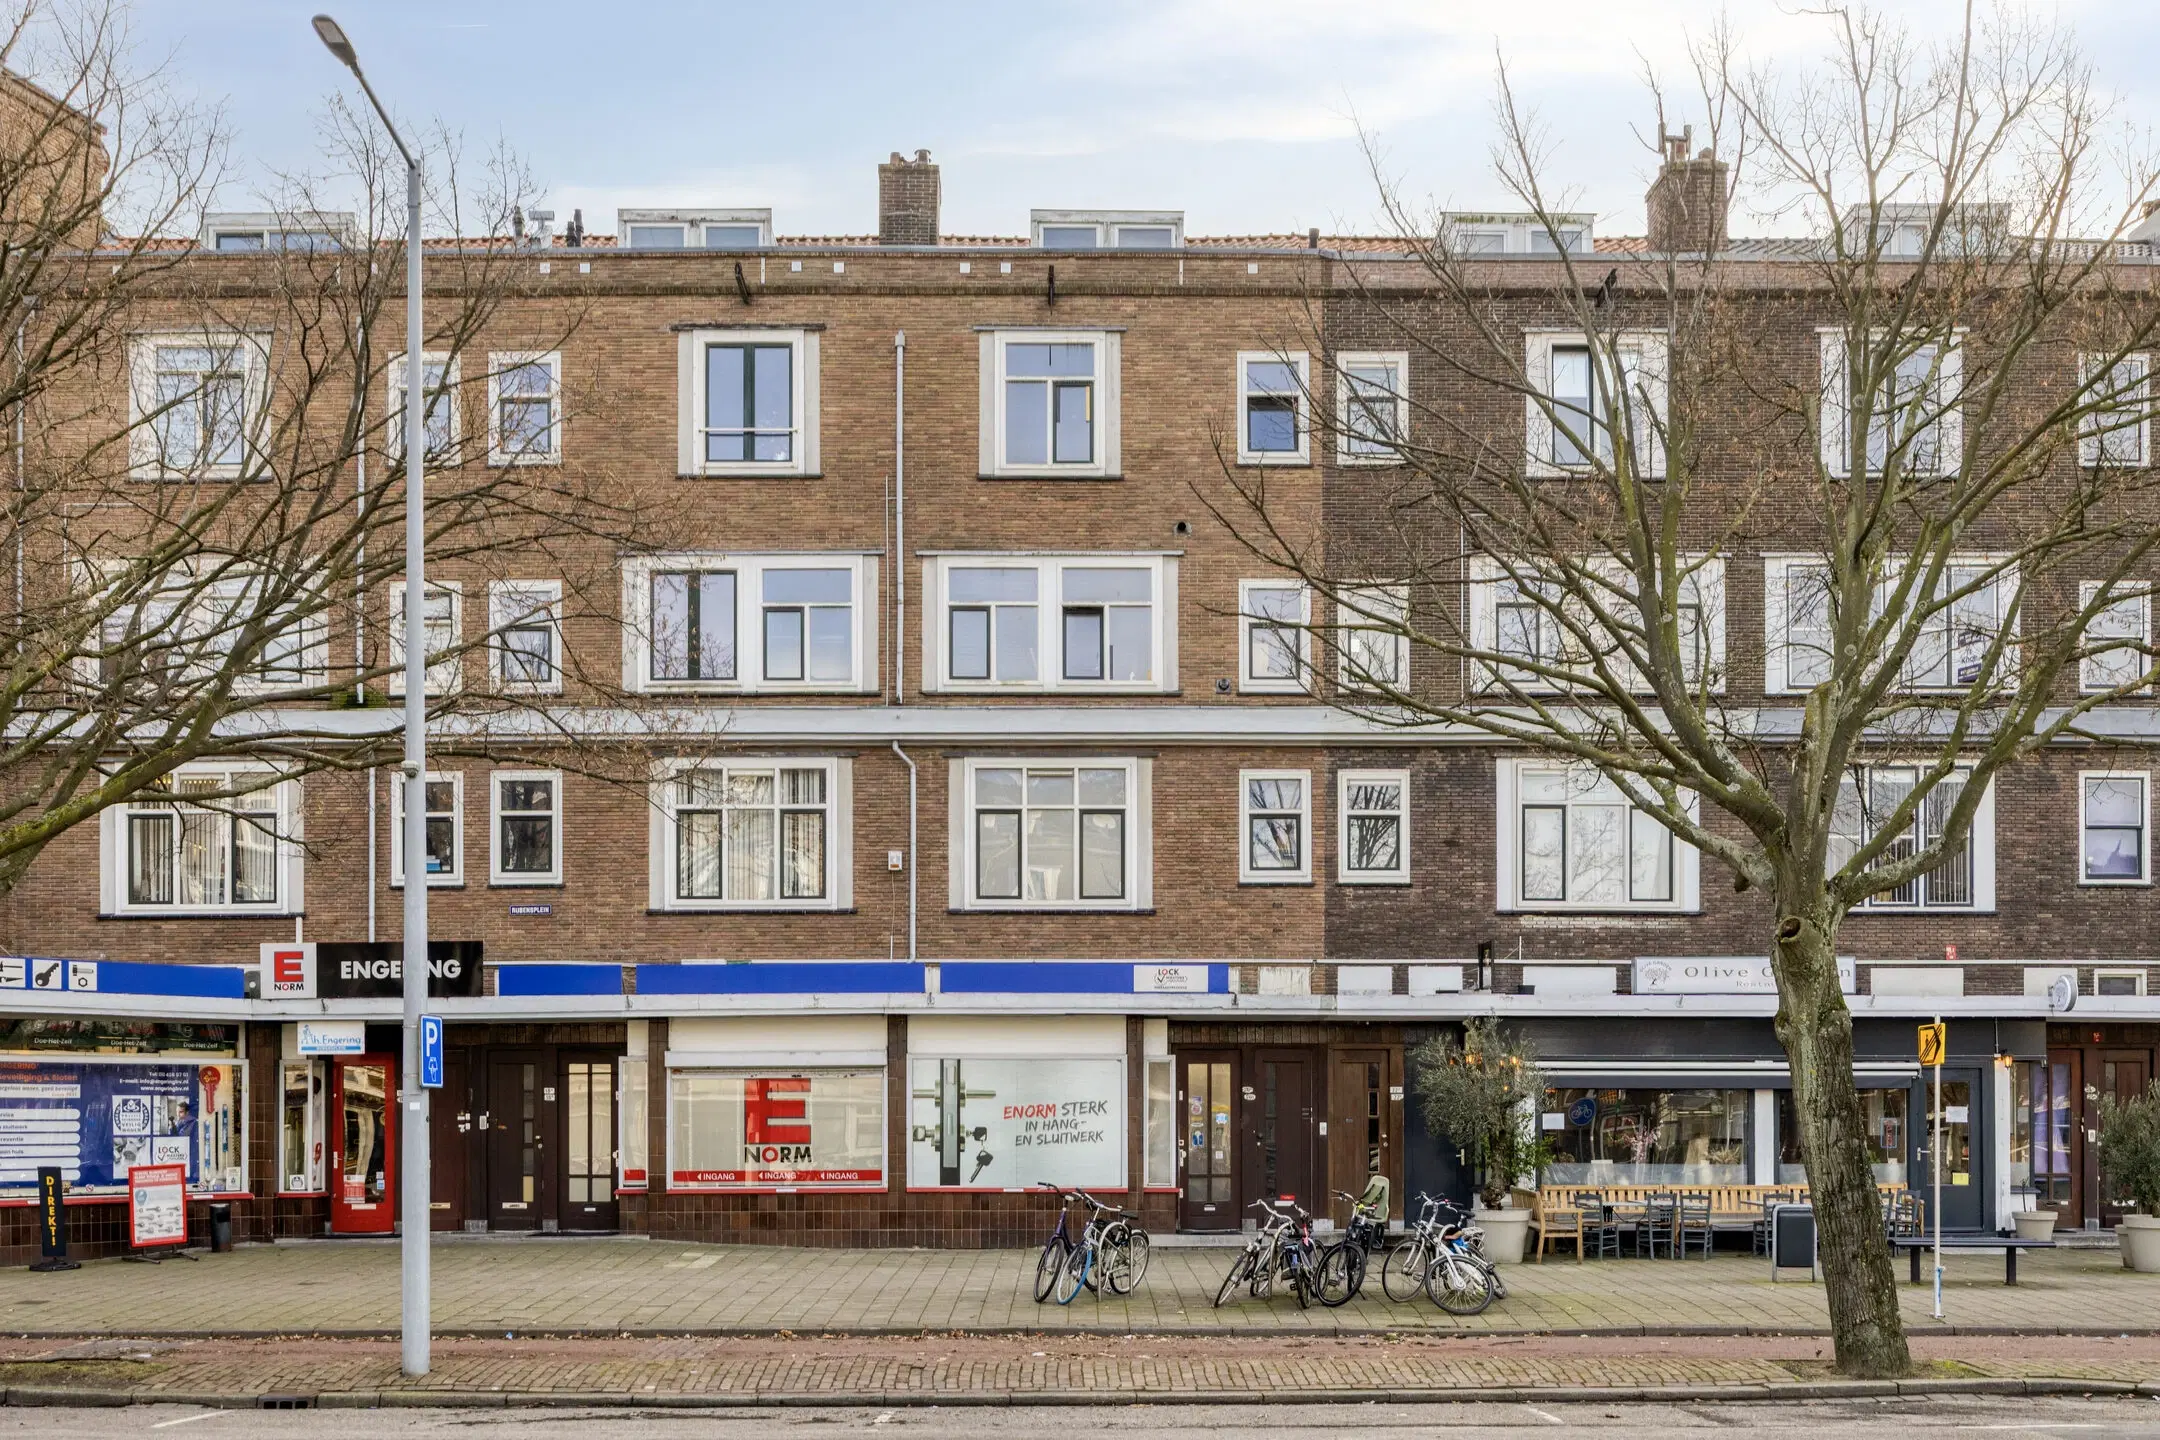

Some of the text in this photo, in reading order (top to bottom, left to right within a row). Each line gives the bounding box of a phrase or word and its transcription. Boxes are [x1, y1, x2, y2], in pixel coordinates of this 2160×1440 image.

[274, 951, 304, 982] E
[341, 959, 462, 980] ENGENG
[1158, 968, 1180, 976] LOCK
[1684, 966, 1749, 978] Olive
[274, 983, 304, 991] NORM
[425, 1021, 438, 1057] P
[744, 1078, 811, 1144] E
[1003, 1100, 1108, 1120] ENORM STERK
[1025, 1119, 1087, 1132] IN HANG-
[1015, 1130, 1104, 1147] EN SLUITWERK
[745, 1146, 812, 1163] NORM
[703, 1172, 859, 1181] INGANG INGANG INGANG
[45, 1175, 57, 1246] DIREKT!
